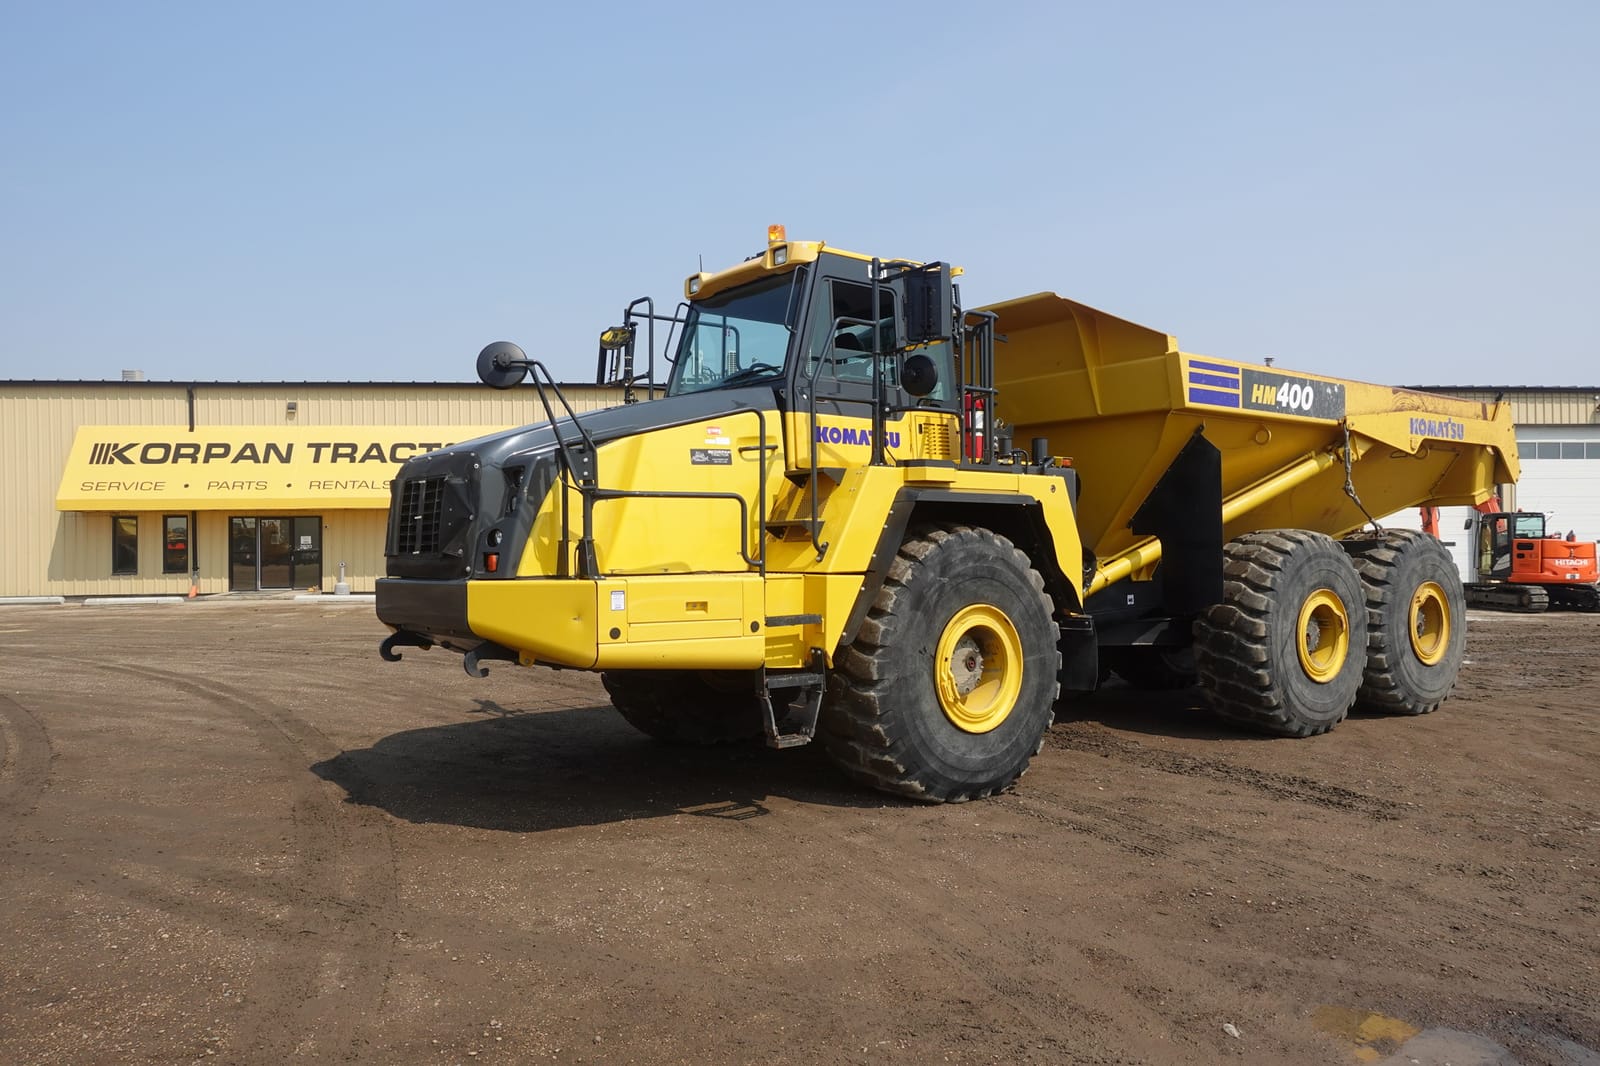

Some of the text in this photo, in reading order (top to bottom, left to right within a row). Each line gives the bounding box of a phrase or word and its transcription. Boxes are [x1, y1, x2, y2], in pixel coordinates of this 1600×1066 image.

[816, 426, 900, 448] KOMAU
[1410, 417, 1464, 440] KOMATSU
[89, 443, 456, 464] KORPAN TRACT
[80, 481, 166, 491] SERVICE
[207, 480, 268, 490] PARTS
